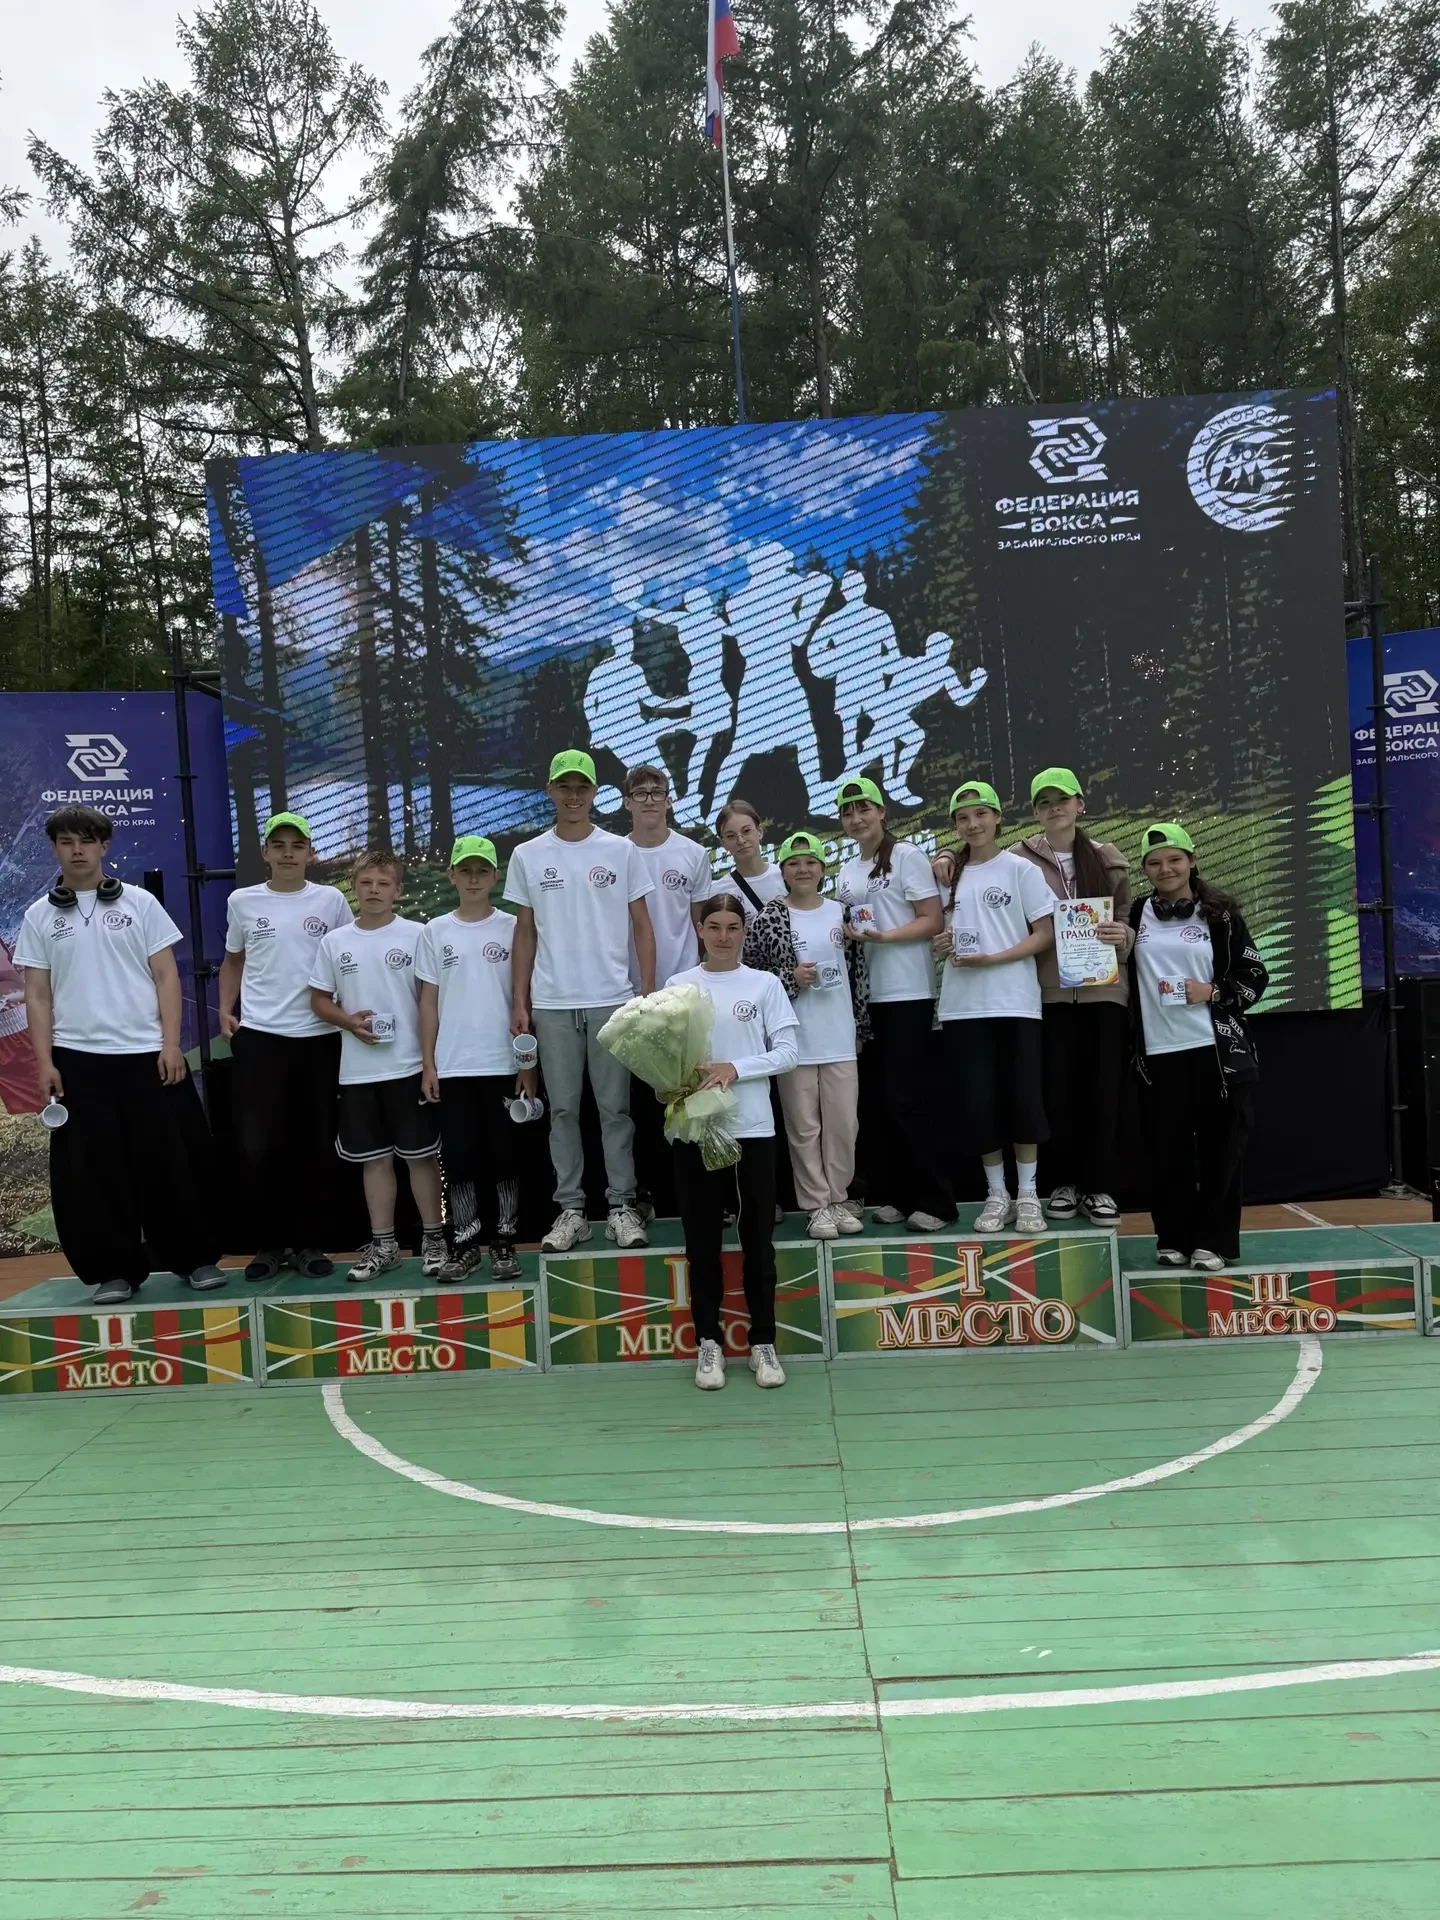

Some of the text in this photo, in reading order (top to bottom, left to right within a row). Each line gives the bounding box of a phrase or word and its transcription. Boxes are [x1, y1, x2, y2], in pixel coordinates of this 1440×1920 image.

[995, 490, 1140, 514] ФЕДЕРАЦИЯ
[1030, 513, 1107, 533] БОКСА
[997, 533, 1141, 550] ЗАБАЙКАЛЬСКОГО КРАЯ
[1356, 751, 1439, 766] ЗАБАКАЛЬСКОГО
[40, 787, 154, 803] ФЕДЕРАЦИЯ
[95, 804, 129, 816] КСА
[132, 818, 156, 827] КРАЯ
[1060, 929, 1097, 939] ГРАМО
[876, 1298, 1079, 1349] МЕСТО
[1208, 1305, 1337, 1337] МЕСТО
[616, 1320, 752, 1356] МЕСО
[345, 1343, 456, 1375] МЕСТО
[64, 1357, 175, 1389] МЕСТО
